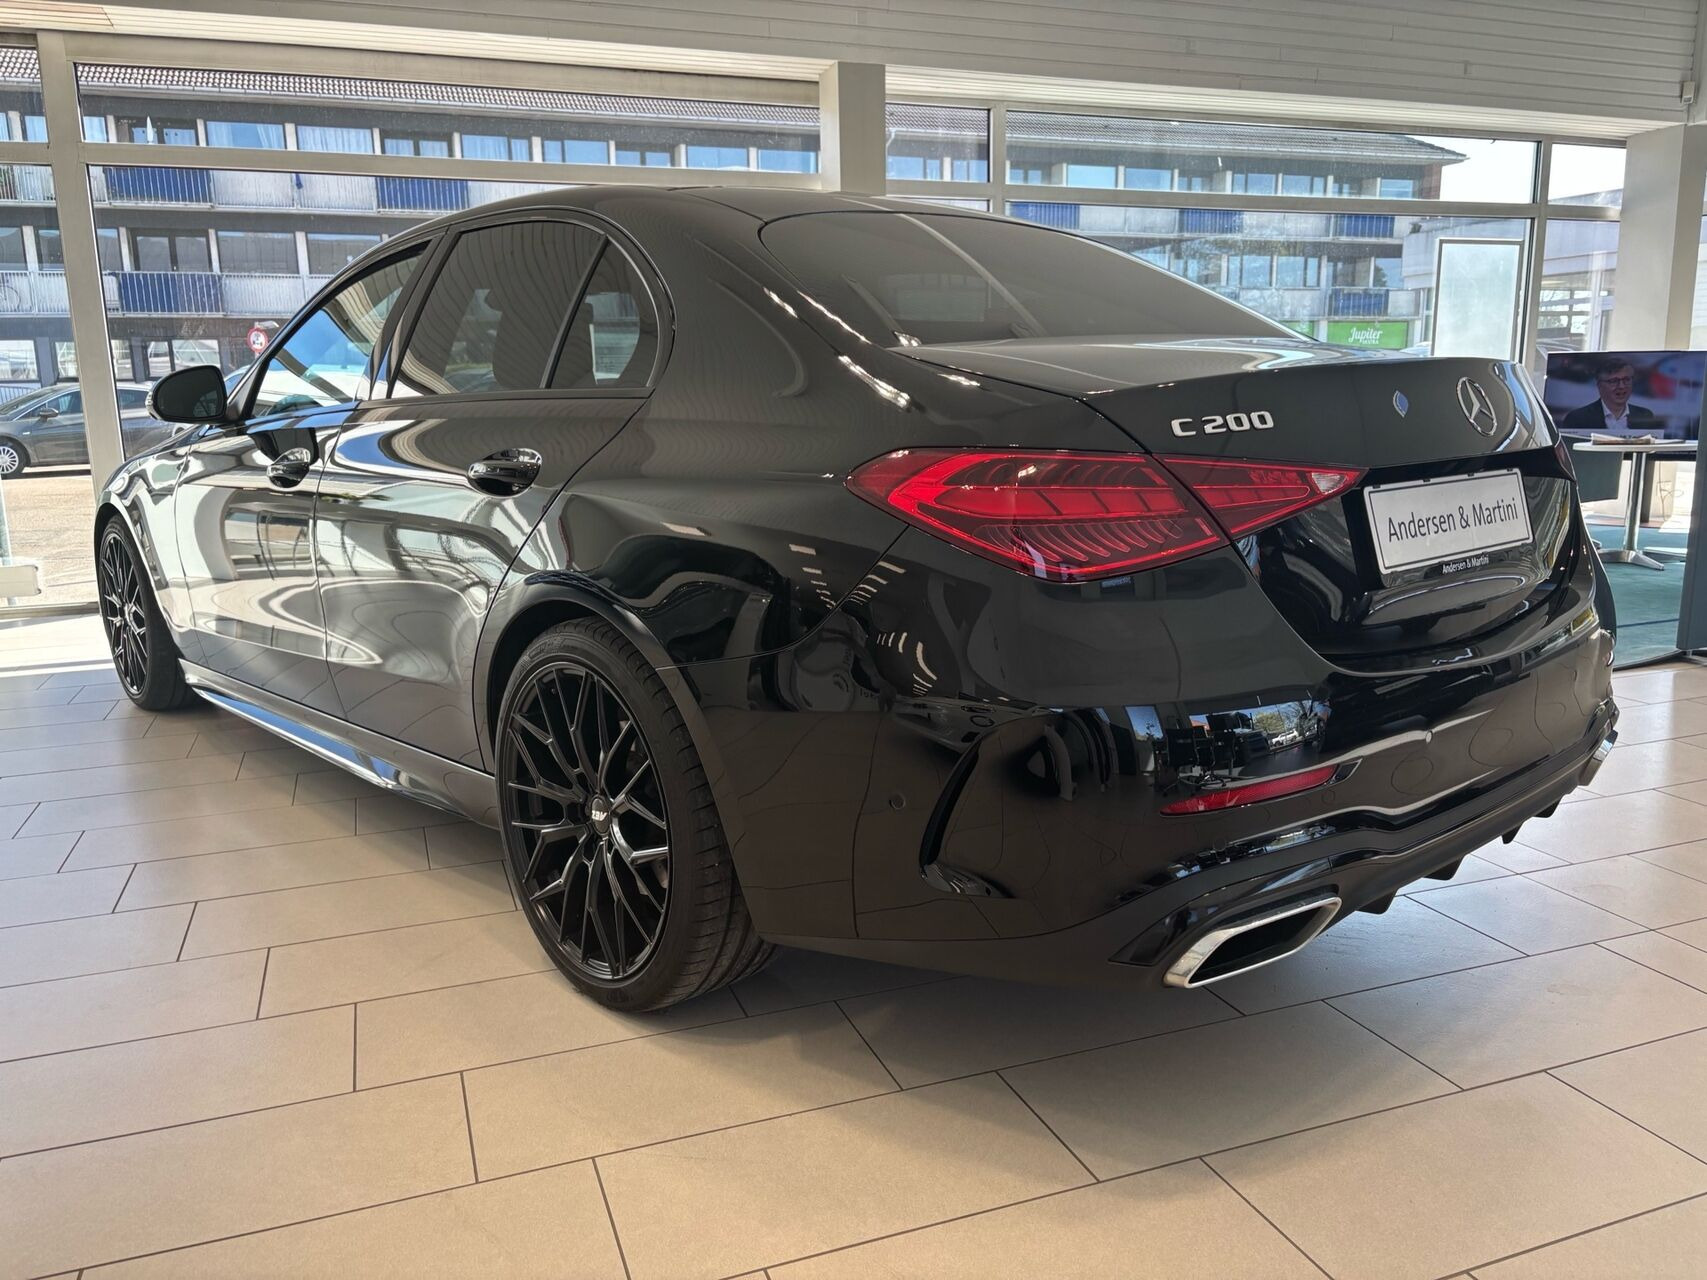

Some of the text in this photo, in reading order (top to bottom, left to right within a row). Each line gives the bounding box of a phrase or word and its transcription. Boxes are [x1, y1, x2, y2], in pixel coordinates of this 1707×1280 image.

[1348, 328, 1383, 343] Jupiter
[1171, 410, 1274, 437] C 200
[1388, 498, 1518, 542] Andersen & Martini
[1442, 561, 1466, 574] Andersen
[1471, 554, 1489, 568] Martini
